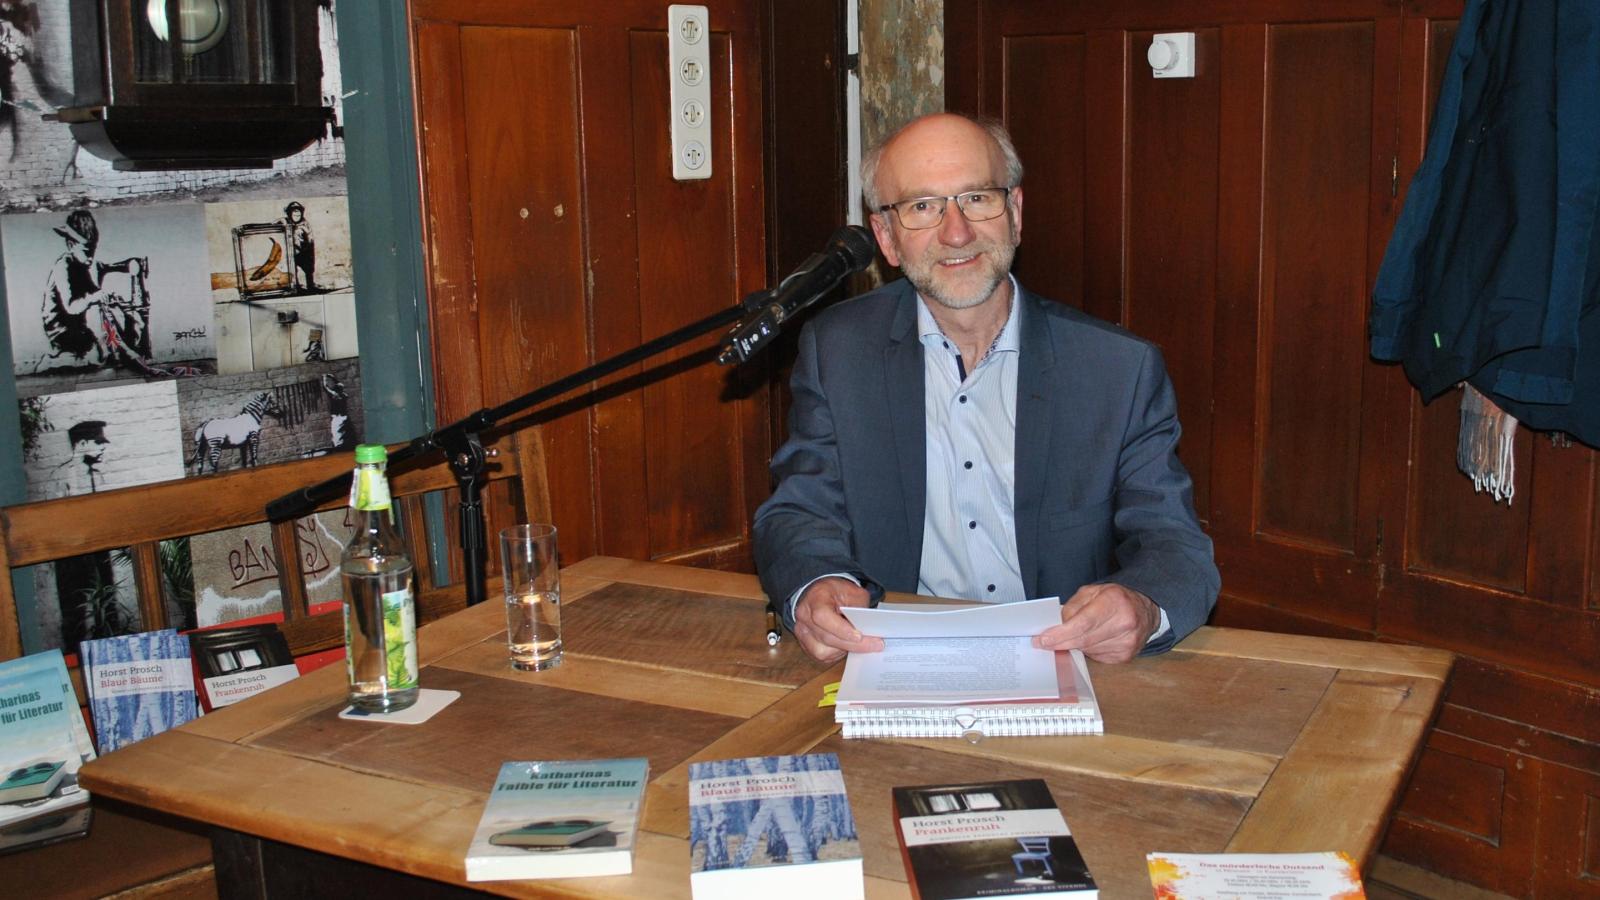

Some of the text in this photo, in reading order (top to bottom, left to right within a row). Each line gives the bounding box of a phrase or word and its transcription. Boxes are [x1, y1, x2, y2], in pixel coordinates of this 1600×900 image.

[100, 665, 163, 678] Horst Prosch
[101, 675, 163, 688] Blaue Bäume
[212, 674, 267, 689] Horst Prosch
[215, 683, 265, 697] Frankenruh
[0, 691, 41, 709] harinas
[1, 701, 64, 725] für Literatur
[530, 771, 612, 780] Katharinas
[498, 779, 638, 791] Faible für Literatur
[700, 775, 796, 790] Horst Prosch
[701, 786, 742, 797] Blaue
[912, 815, 1006, 828] Horst Prosch
[914, 823, 1001, 836] Frankenruh
